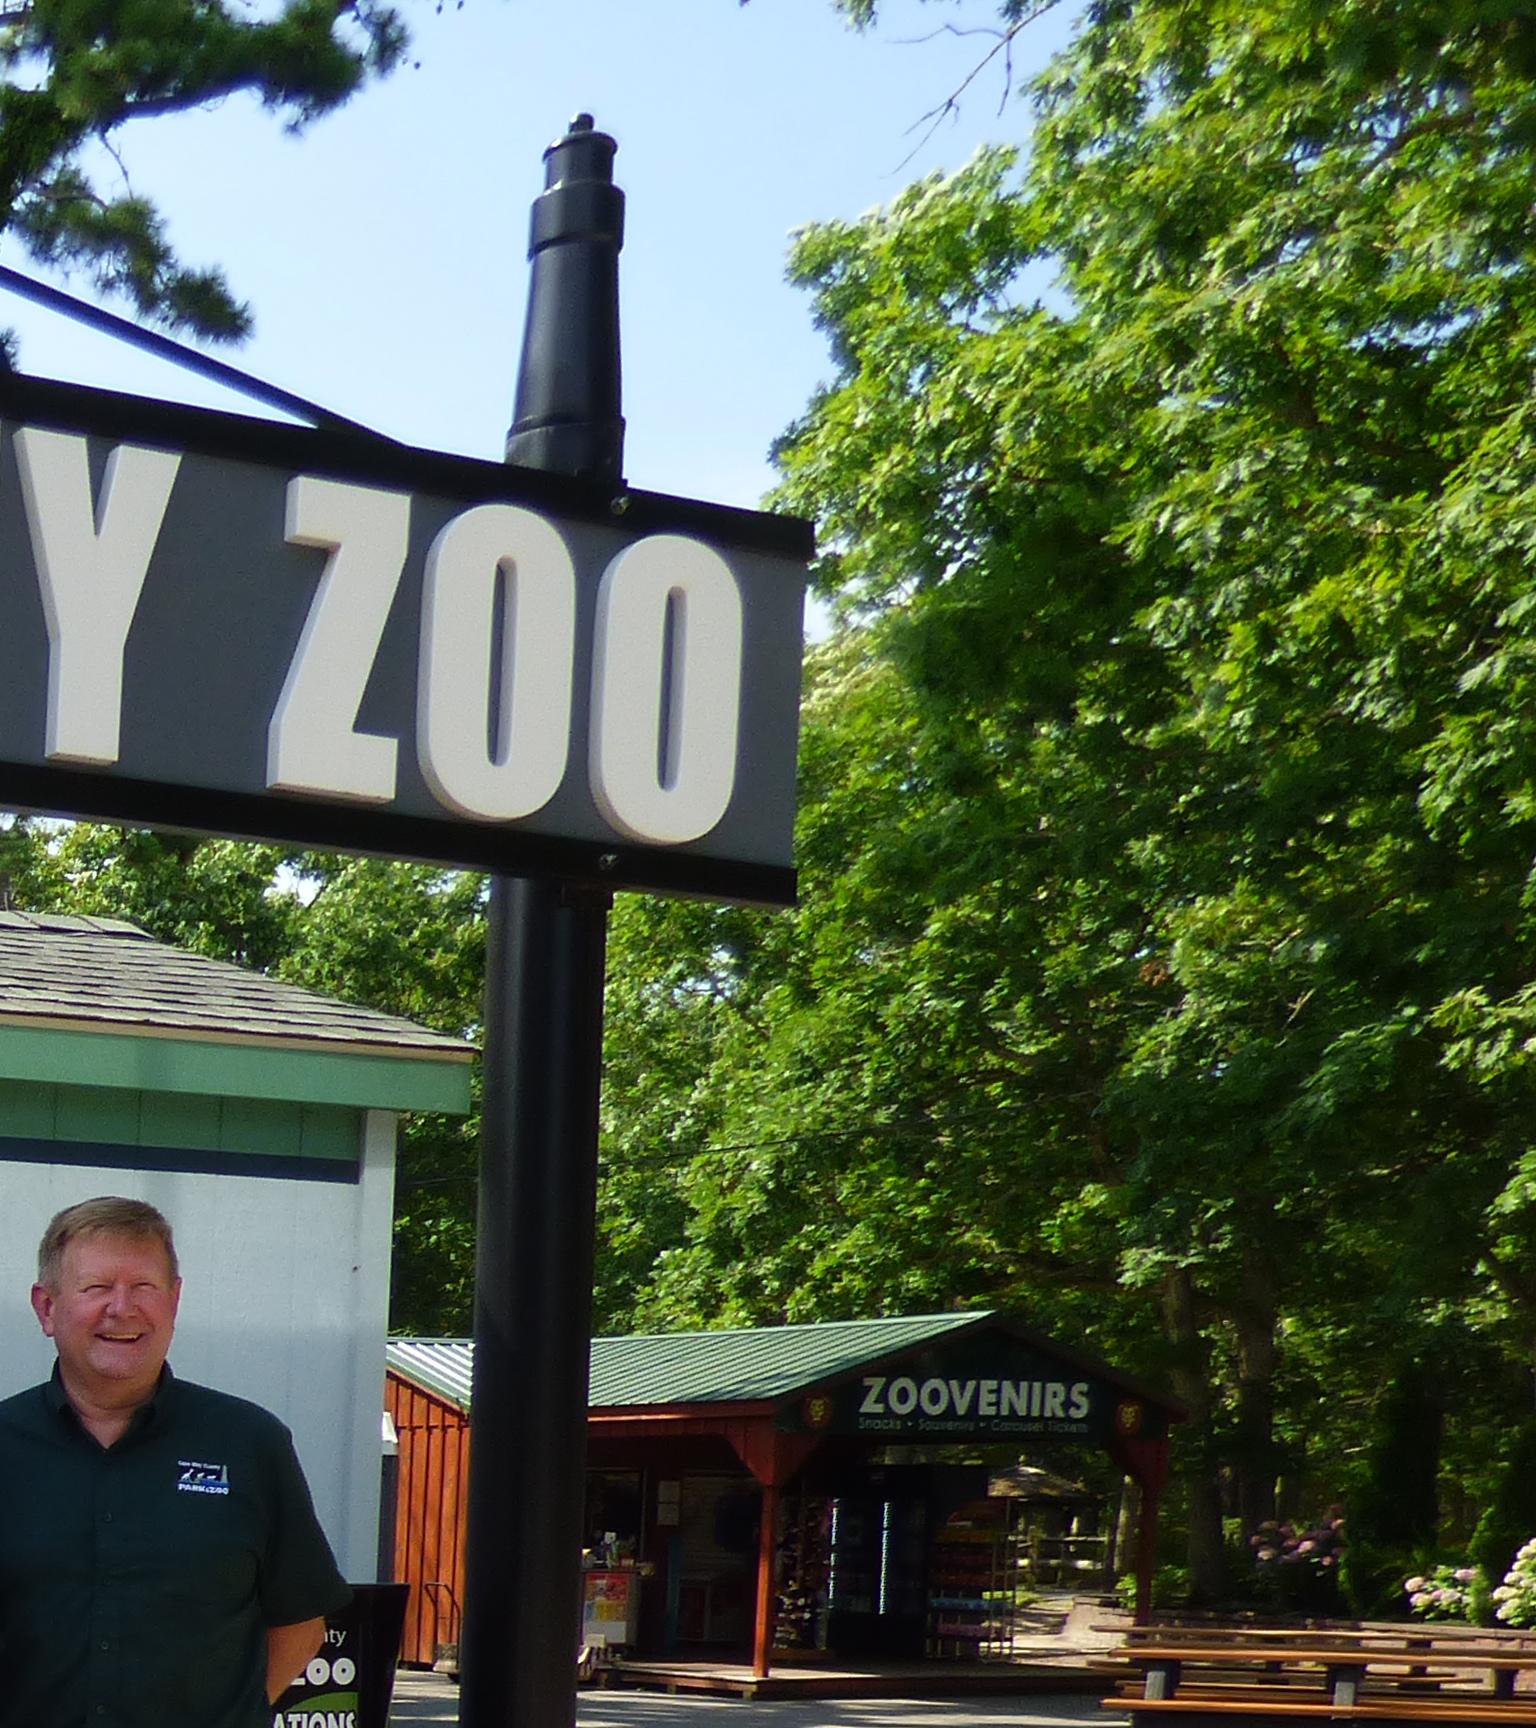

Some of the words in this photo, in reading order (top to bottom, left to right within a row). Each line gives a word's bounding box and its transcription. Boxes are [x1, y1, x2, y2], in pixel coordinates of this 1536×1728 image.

[266, 475, 743, 846] ZOO
[858, 1377, 1090, 1419] ZOOVENIRS
[858, 1417, 902, 1430] Snacks
[290, 1657, 356, 1686] OO
